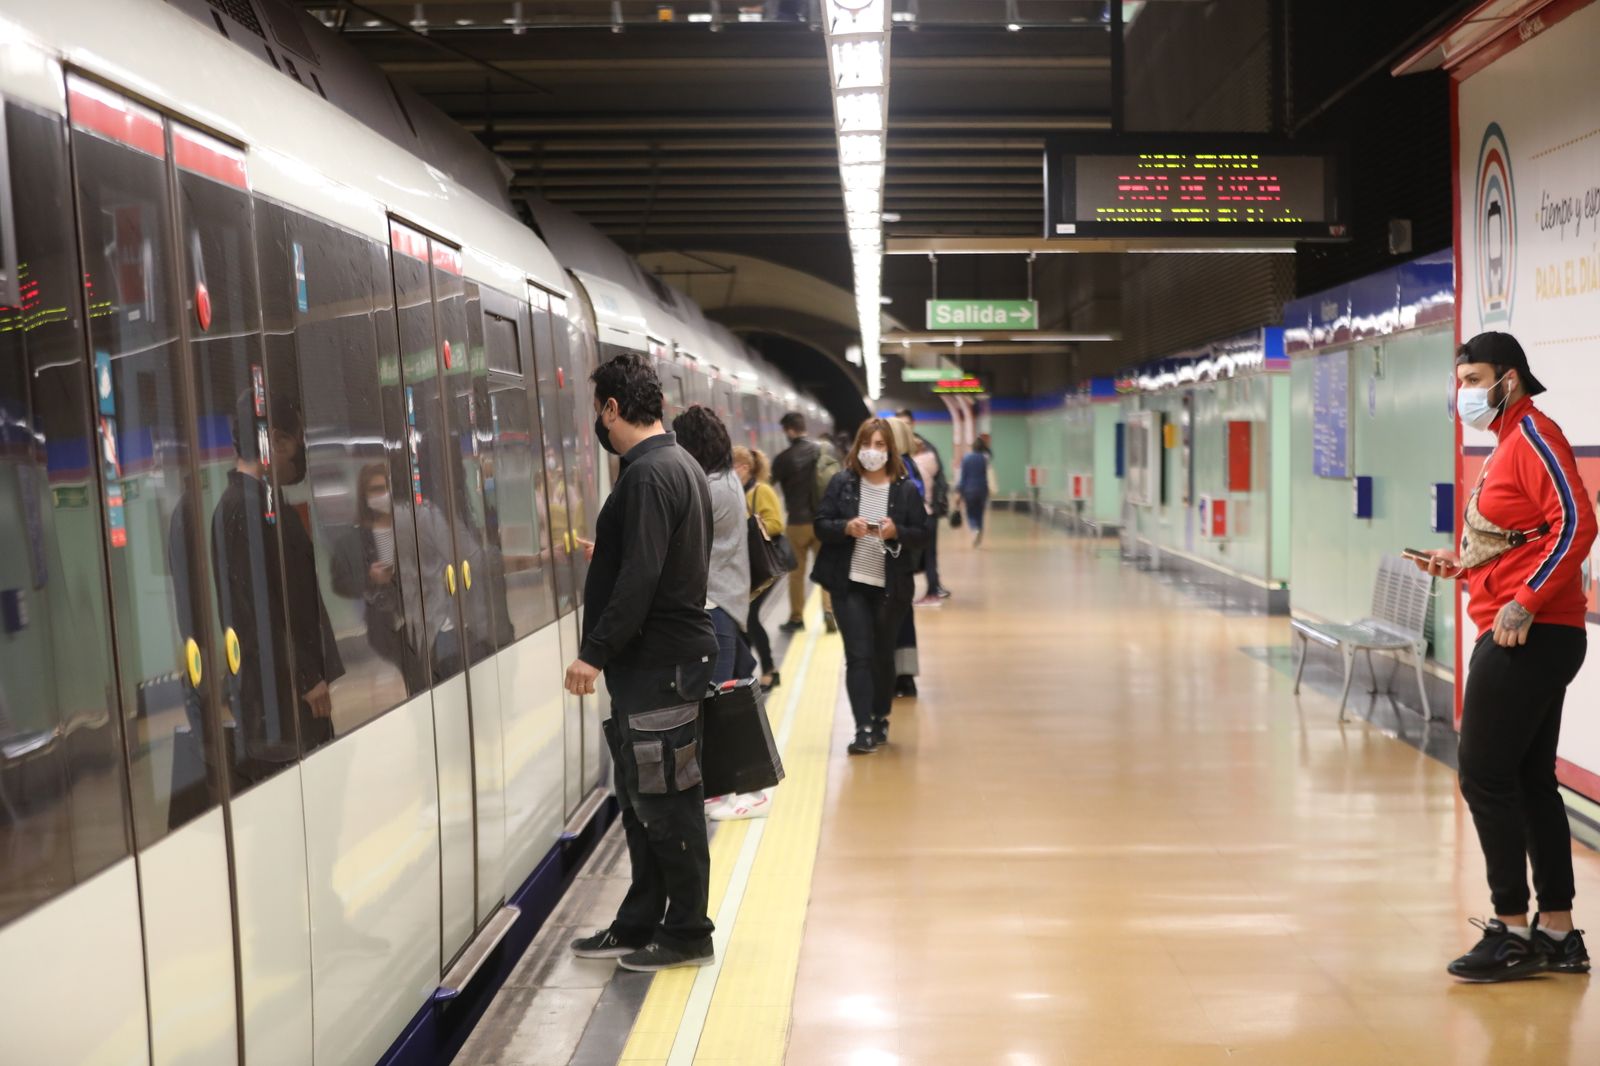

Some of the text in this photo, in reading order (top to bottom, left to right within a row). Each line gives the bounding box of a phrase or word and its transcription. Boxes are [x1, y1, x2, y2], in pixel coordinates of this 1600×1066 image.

[1540, 189, 1574, 241] tiempo
[1575, 197, 1582, 238] y
[1535, 262, 1562, 300] PARA
[1563, 257, 1579, 297] EL
[935, 304, 1008, 324] Salida
